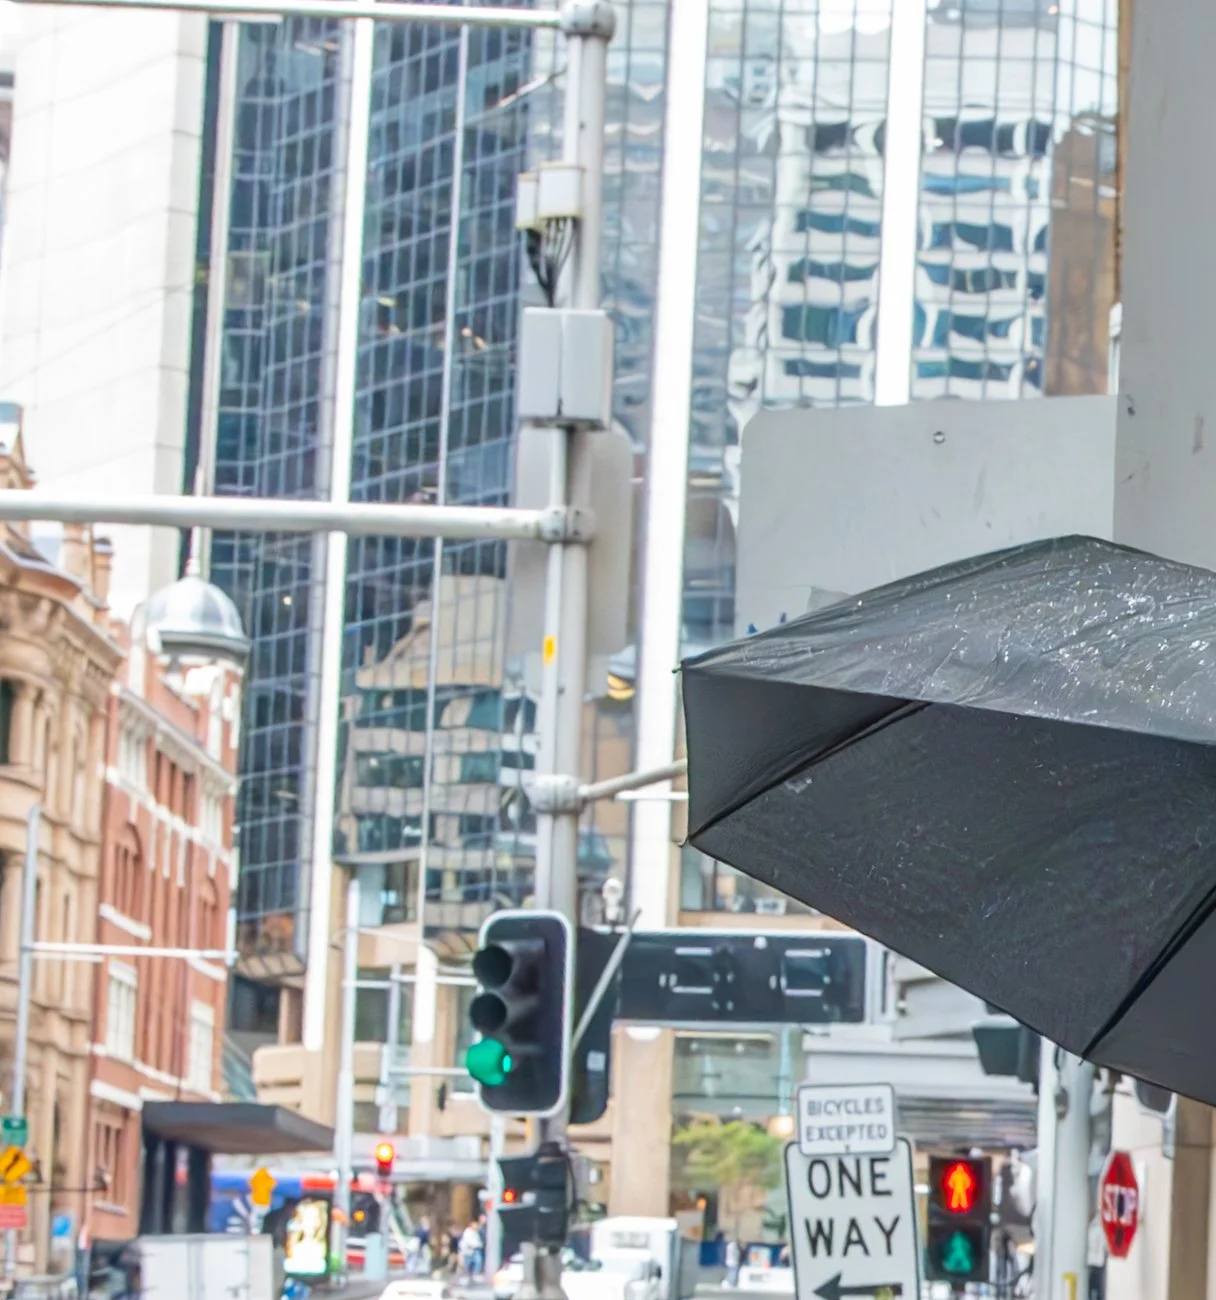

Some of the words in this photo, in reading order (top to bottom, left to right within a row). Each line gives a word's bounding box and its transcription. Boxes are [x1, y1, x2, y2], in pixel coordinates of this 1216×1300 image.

[806, 1097, 885, 1116] BICYCLES
[805, 1123, 888, 1142] EXCEPTED
[808, 1157, 893, 1199] ONE
[1103, 1183, 1137, 1226] STOP
[804, 1214, 900, 1258] WAY
